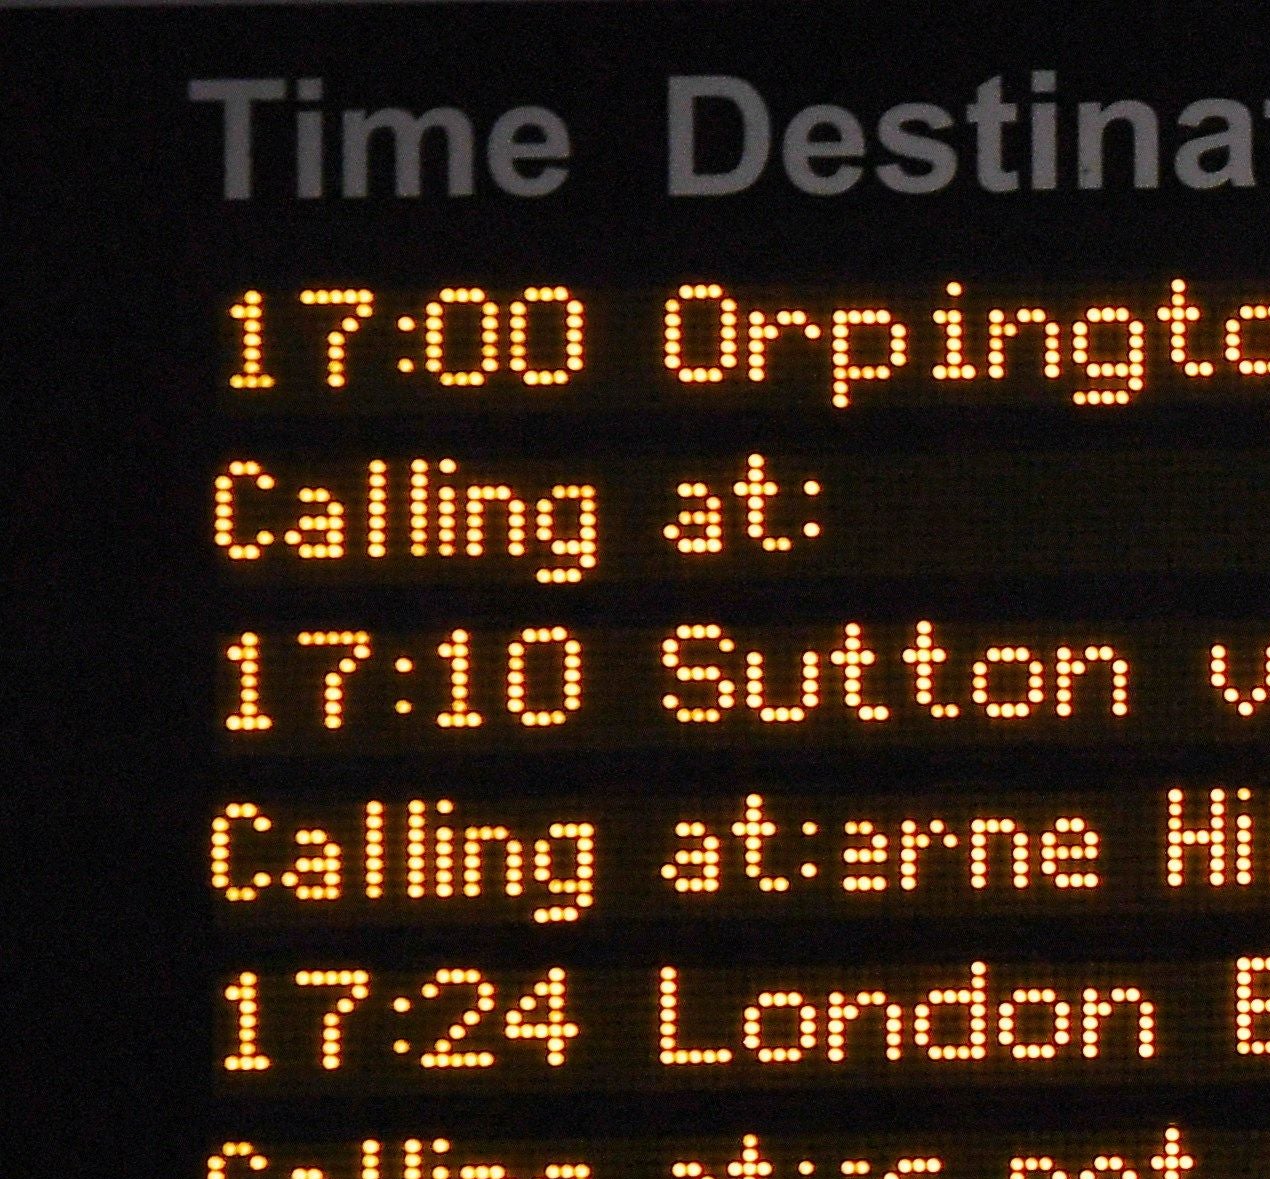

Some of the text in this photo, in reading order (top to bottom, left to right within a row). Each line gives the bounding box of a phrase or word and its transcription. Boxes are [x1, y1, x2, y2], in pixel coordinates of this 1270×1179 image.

[189, 77, 572, 199] Time
[229, 286, 586, 390] 17:00
[214, 453, 823, 586] Calling at:
[225, 626, 584, 732] 17:10
[662, 620, 1130, 724] Sutton
[210, 799, 597, 926] Calling
[223, 967, 581, 1073] 17:24
[659, 961, 1157, 1067] London
